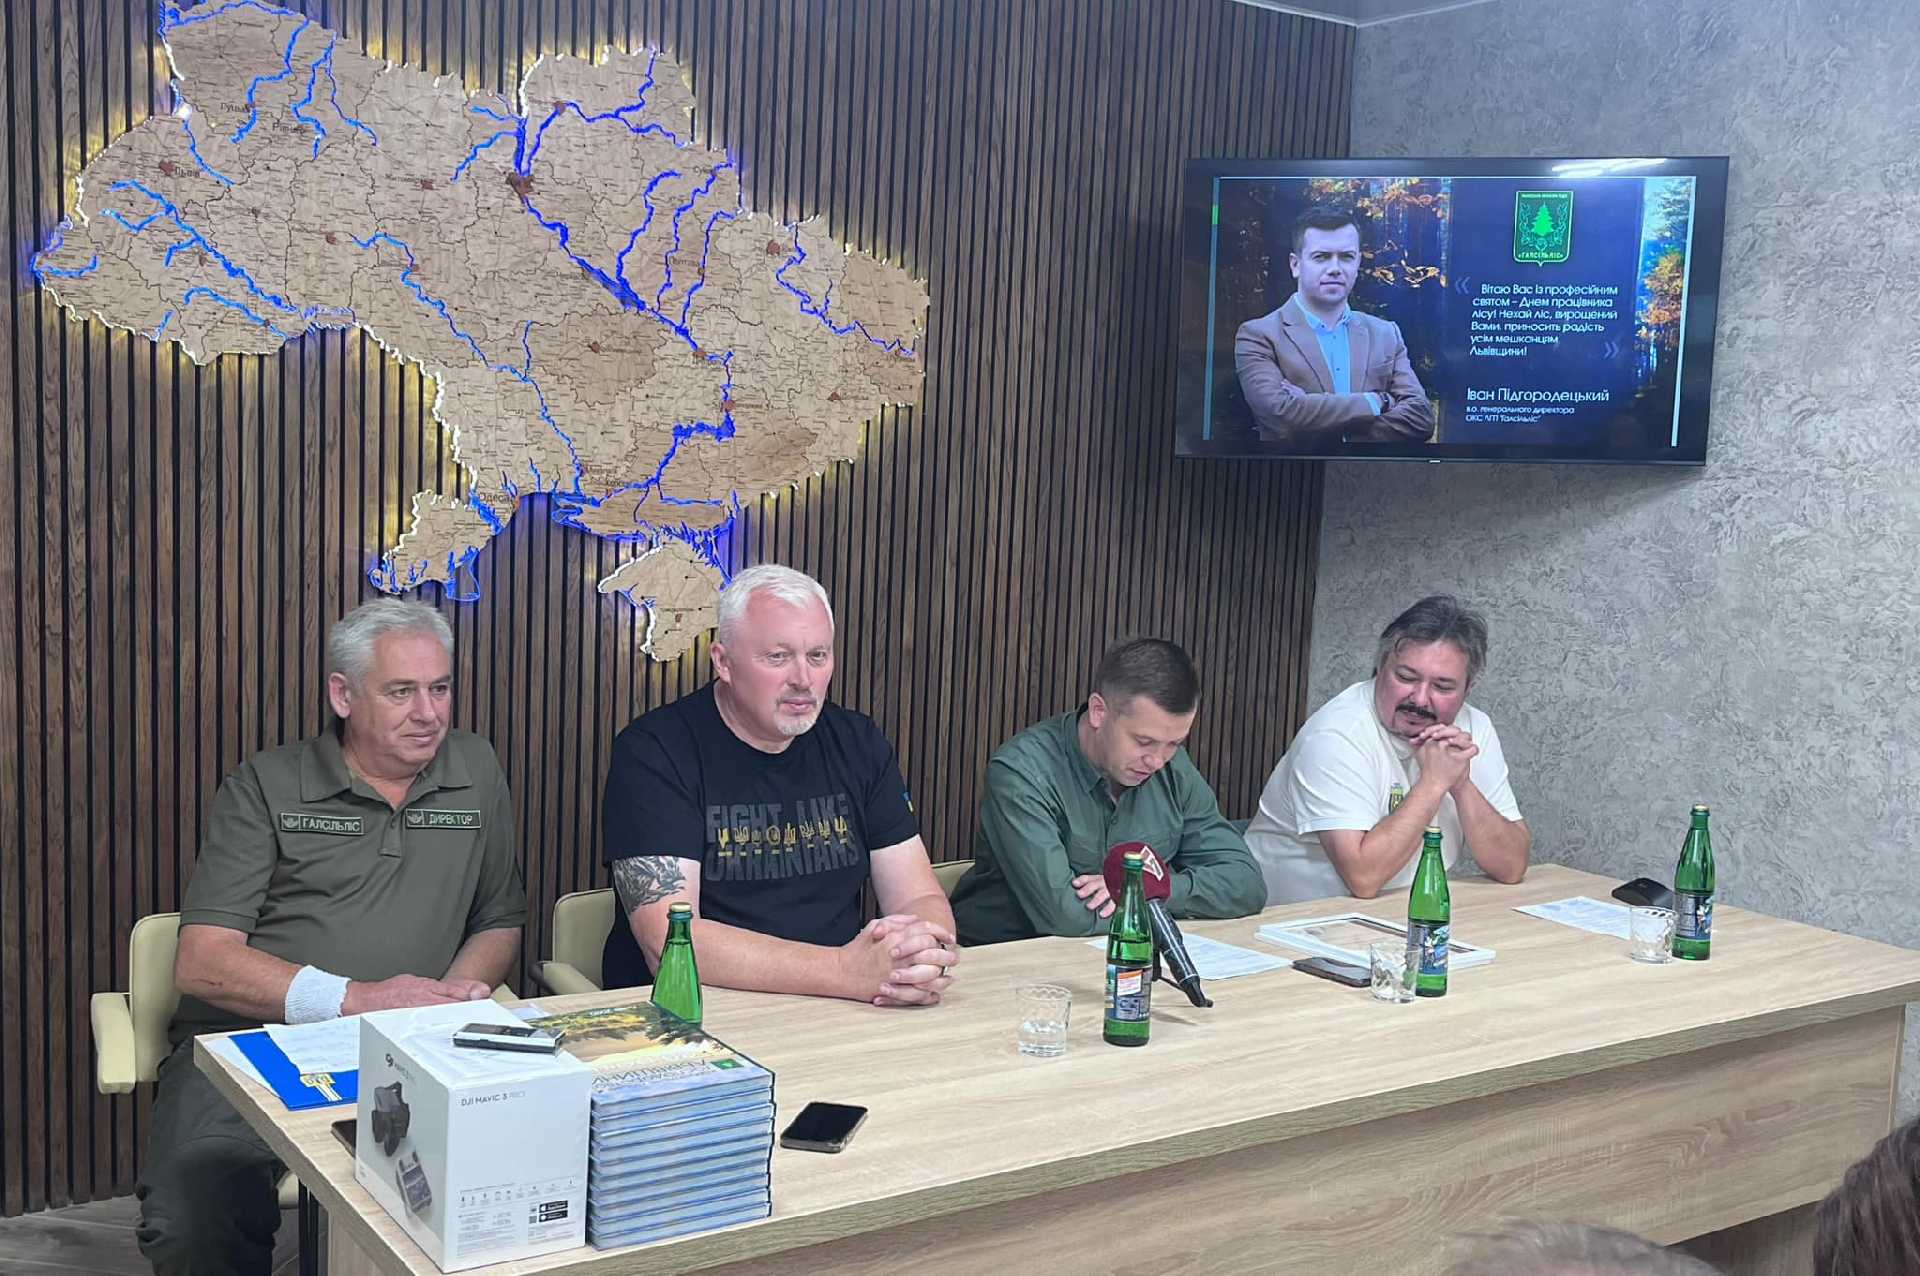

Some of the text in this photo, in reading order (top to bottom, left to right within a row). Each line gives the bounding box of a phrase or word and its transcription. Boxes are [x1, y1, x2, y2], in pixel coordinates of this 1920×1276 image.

[1481, 284, 1511, 295] Вітаю
[1512, 284, 1533, 295] Вас
[1544, 284, 1619, 297] професійним
[1472, 298, 1511, 307] святом
[1519, 297, 1550, 308] Днем
[1551, 297, 1613, 309] працівника
[1467, 387, 1610, 403] Іван Підгородецький
[428, 814, 473, 825] ДИРЕКТОР
[706, 793, 849, 843] FIGHT LIKE
[461, 1097, 474, 1106] DJI
[475, 1094, 501, 1104] MAVIC
